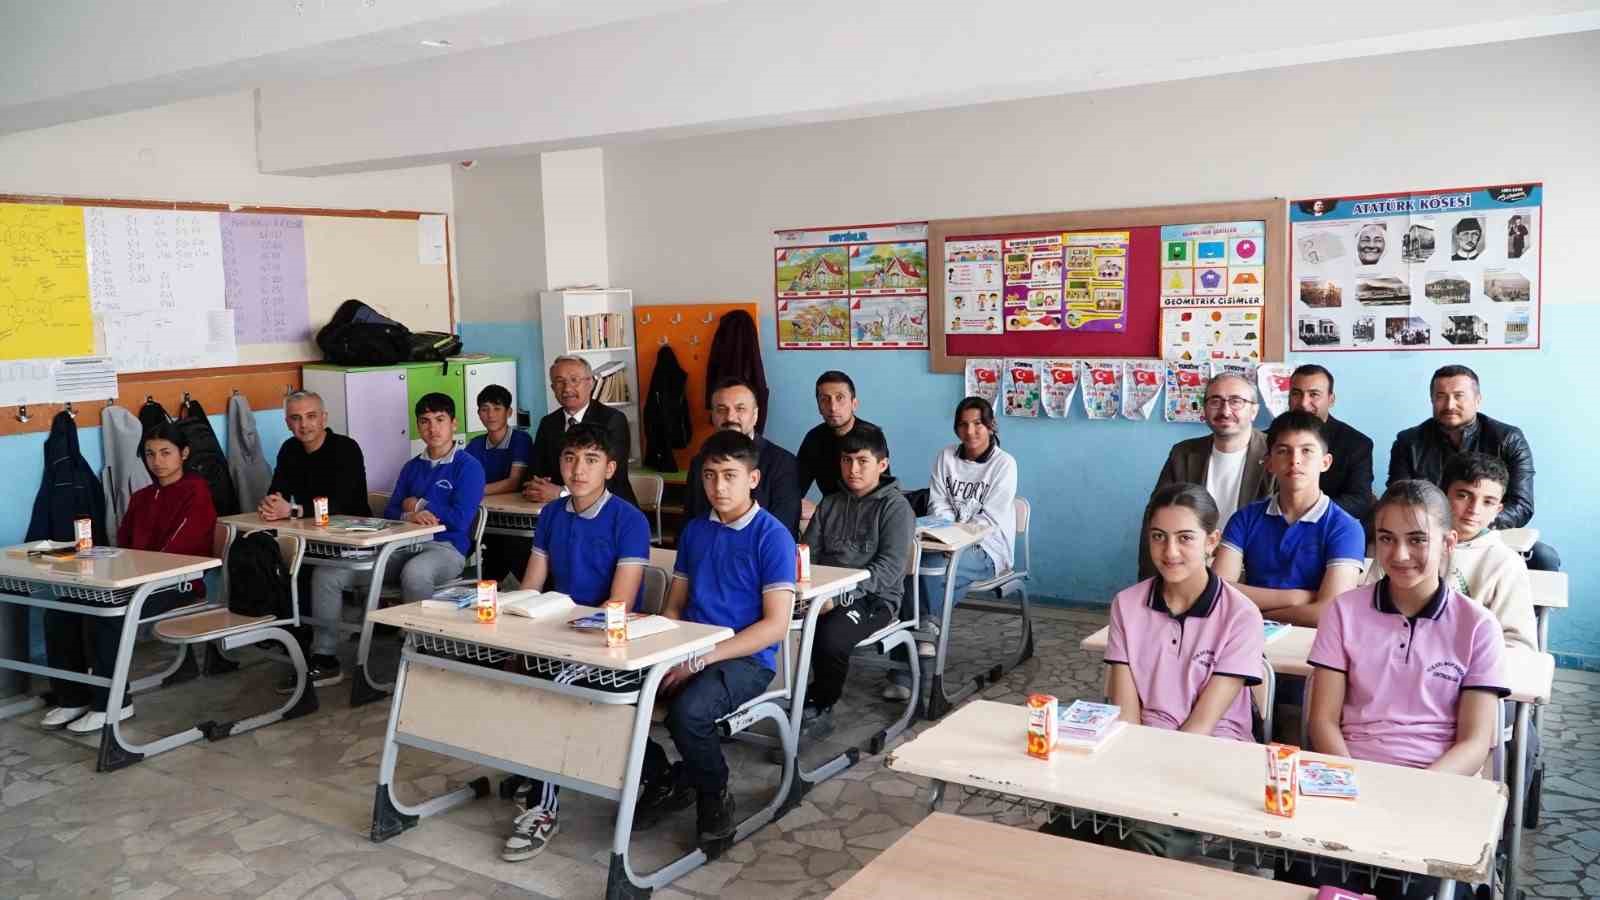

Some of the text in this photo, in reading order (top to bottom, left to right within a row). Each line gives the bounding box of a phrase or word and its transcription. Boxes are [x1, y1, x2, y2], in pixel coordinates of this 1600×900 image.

[1353, 199, 1414, 215] ATATÜRK
[1164, 295, 1260, 306] GEOMETRİK CİSİMLER
